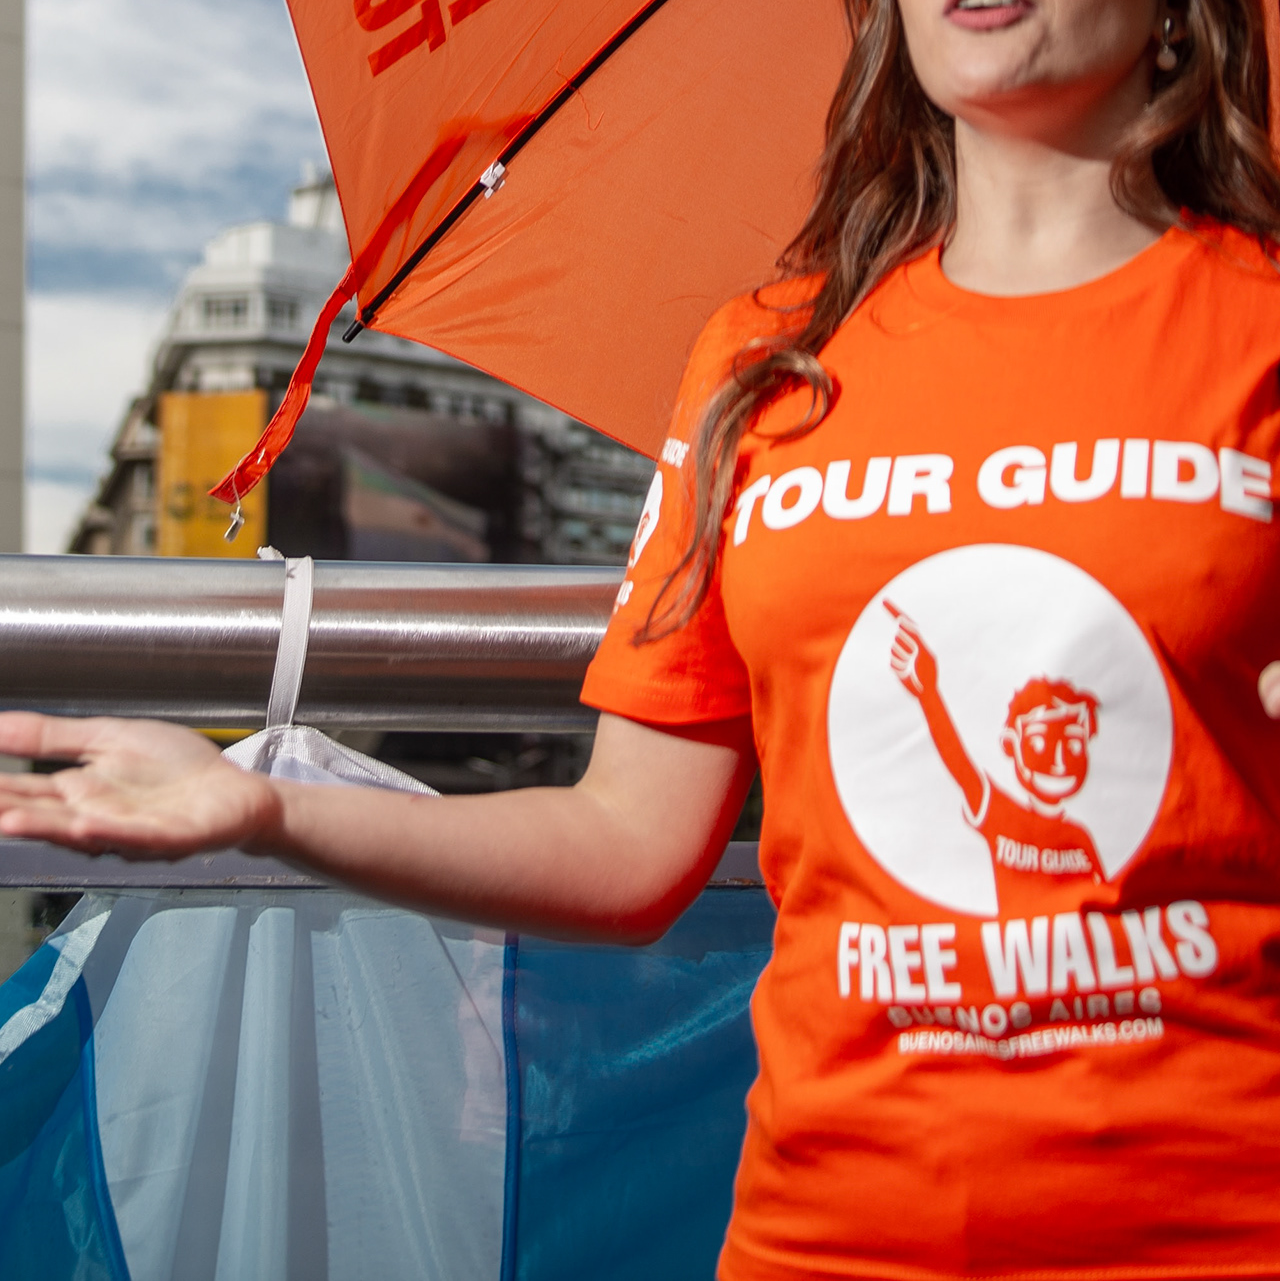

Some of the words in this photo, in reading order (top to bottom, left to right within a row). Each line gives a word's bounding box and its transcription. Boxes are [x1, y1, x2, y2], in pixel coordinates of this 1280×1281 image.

[733, 453, 954, 546] TOUR
[976, 438, 1273, 523] GUIDE
[996, 834, 1039, 872] TOUR
[1041, 848, 1093, 874] GUIDE
[837, 920, 962, 1004] FREE
[980, 899, 1218, 1000] WALKS
[888, 1002, 1033, 1038] BUENOS
[1049, 987, 1163, 1022] AIRES
